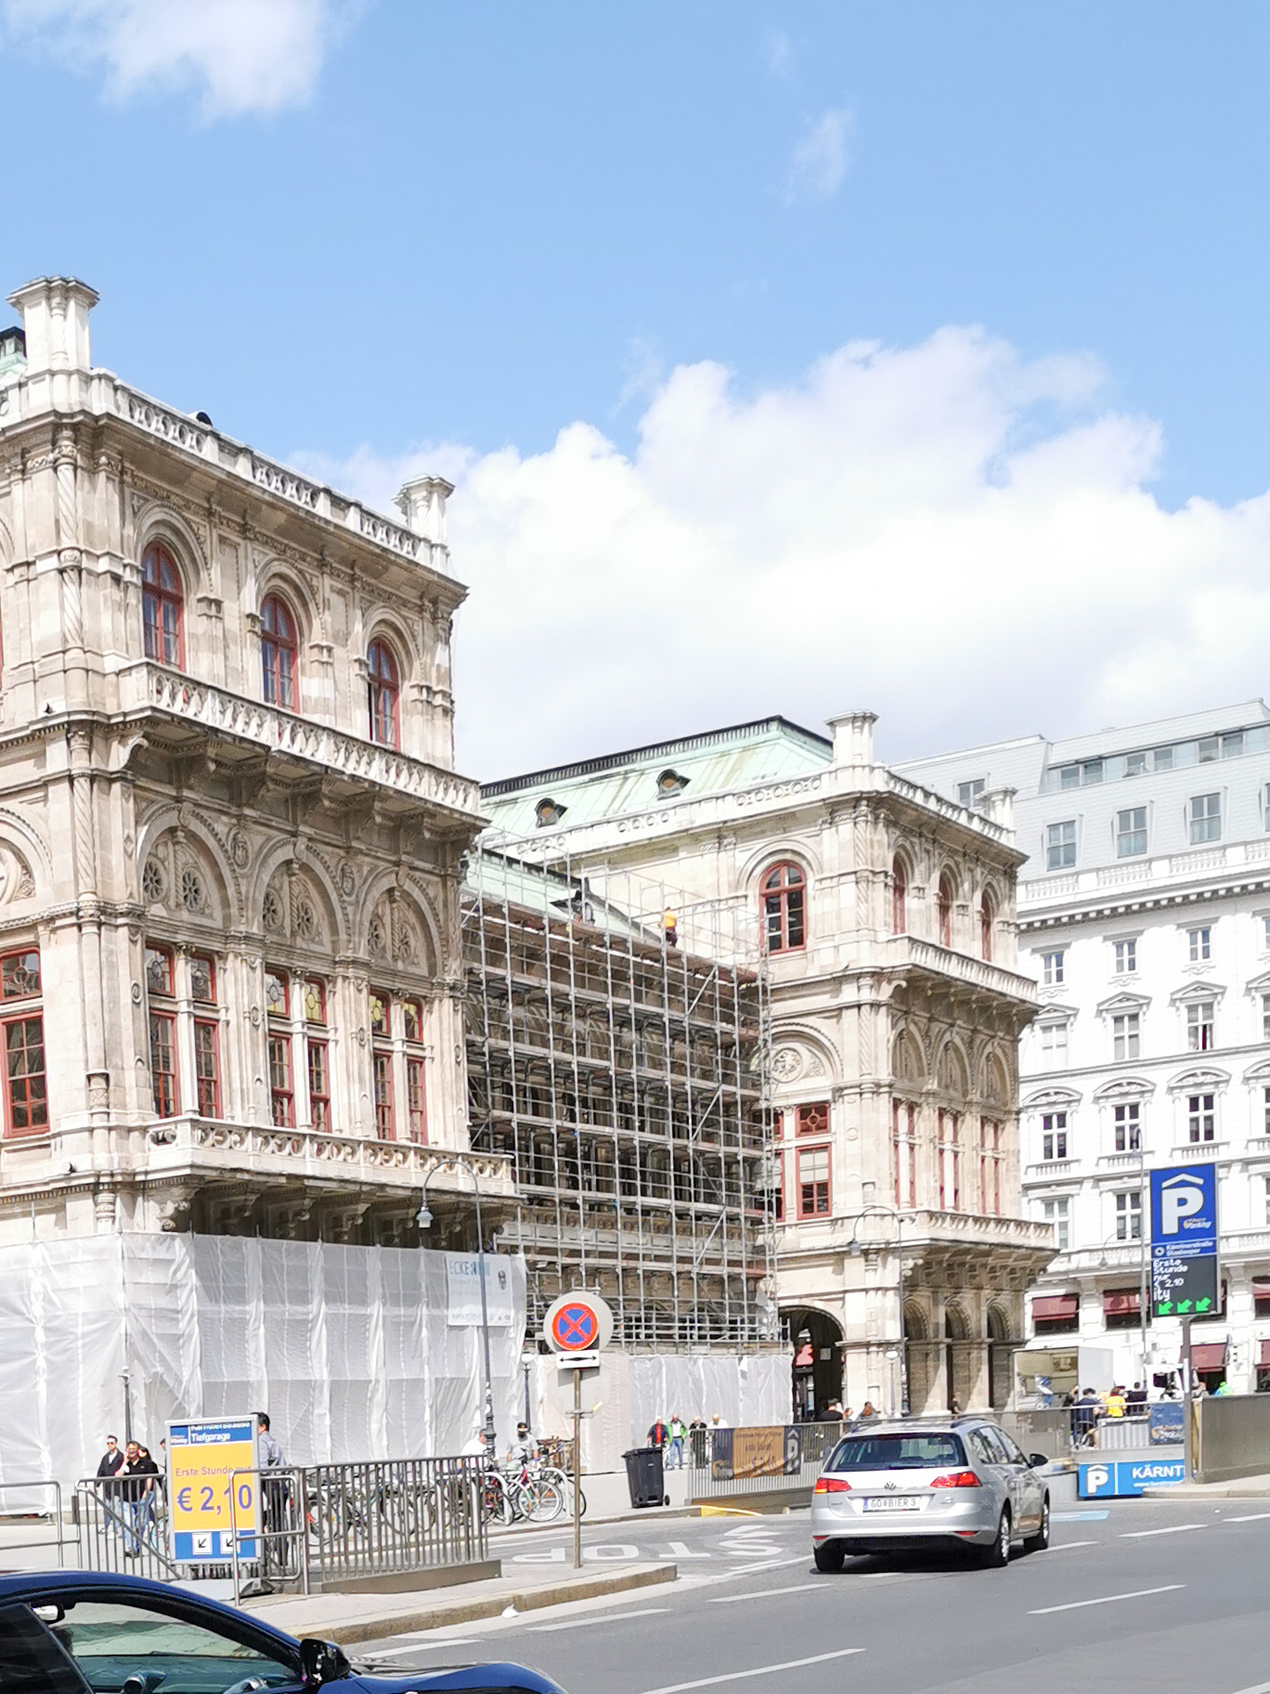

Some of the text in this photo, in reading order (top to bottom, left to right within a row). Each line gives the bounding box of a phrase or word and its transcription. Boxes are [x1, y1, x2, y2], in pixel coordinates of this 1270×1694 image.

[1153, 1259, 1182, 1268] Erste
[1153, 1265, 1188, 1275] Stunde
[1153, 1286, 1170, 1302] ity
[191, 1432, 231, 1442] Tiefgarage
[175, 1467, 198, 1477] Erste
[201, 1465, 233, 1476] Stunde
[1132, 1464, 1185, 1479] KÄRNT
[176, 1487, 193, 1512] €
[512, 1539, 784, 1563] STOP
